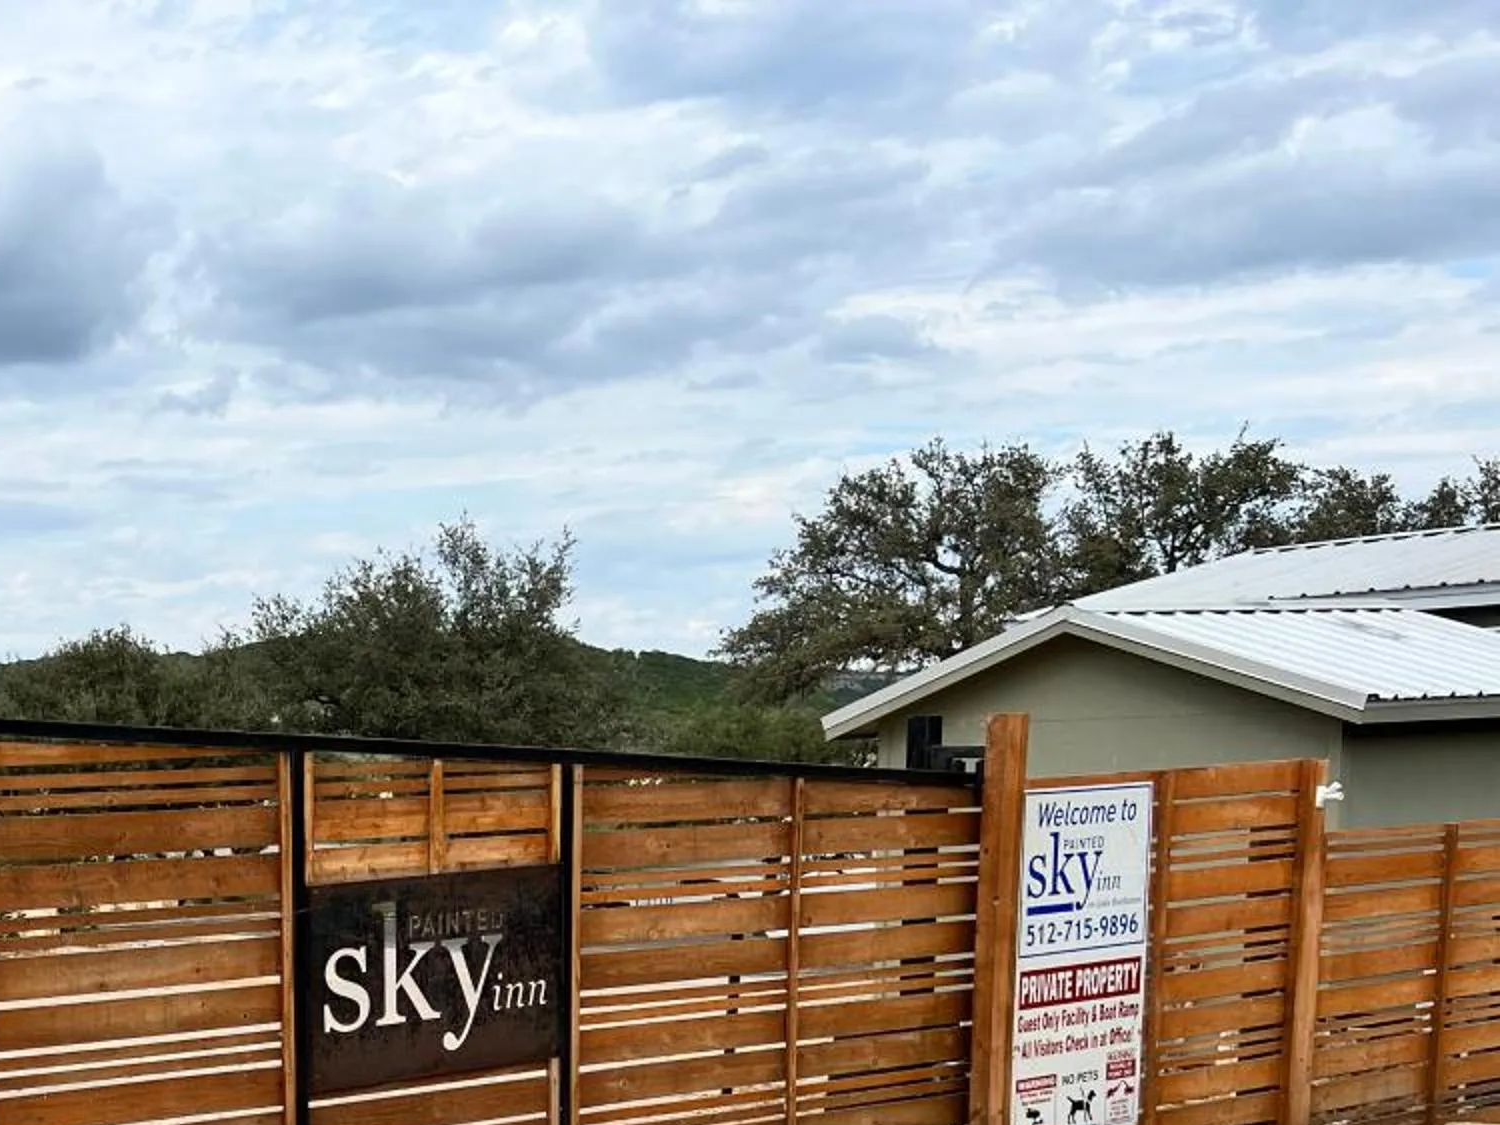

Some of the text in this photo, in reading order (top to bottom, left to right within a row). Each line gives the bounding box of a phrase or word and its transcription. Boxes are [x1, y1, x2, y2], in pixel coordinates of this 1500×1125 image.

[1038, 798, 1137, 828] Welcome to
[1063, 836, 1105, 850] PAINTED
[1027, 831, 1122, 910] sky inn
[408, 910, 504, 937] PAINTED
[1027, 912, 1138, 946] 512-715-9896
[323, 901, 548, 1050] sky inn
[1021, 961, 1139, 1004] PRIVATE PROPERTY
[1018, 1014, 1041, 1033] Guest
[1042, 1012, 1060, 1032] Only
[1062, 1007, 1089, 1028] Facility
[1033, 1039, 1063, 1057] Visitors
[1065, 1032, 1088, 1053] Check
[1061, 1070, 1099, 1085] NO PETS
